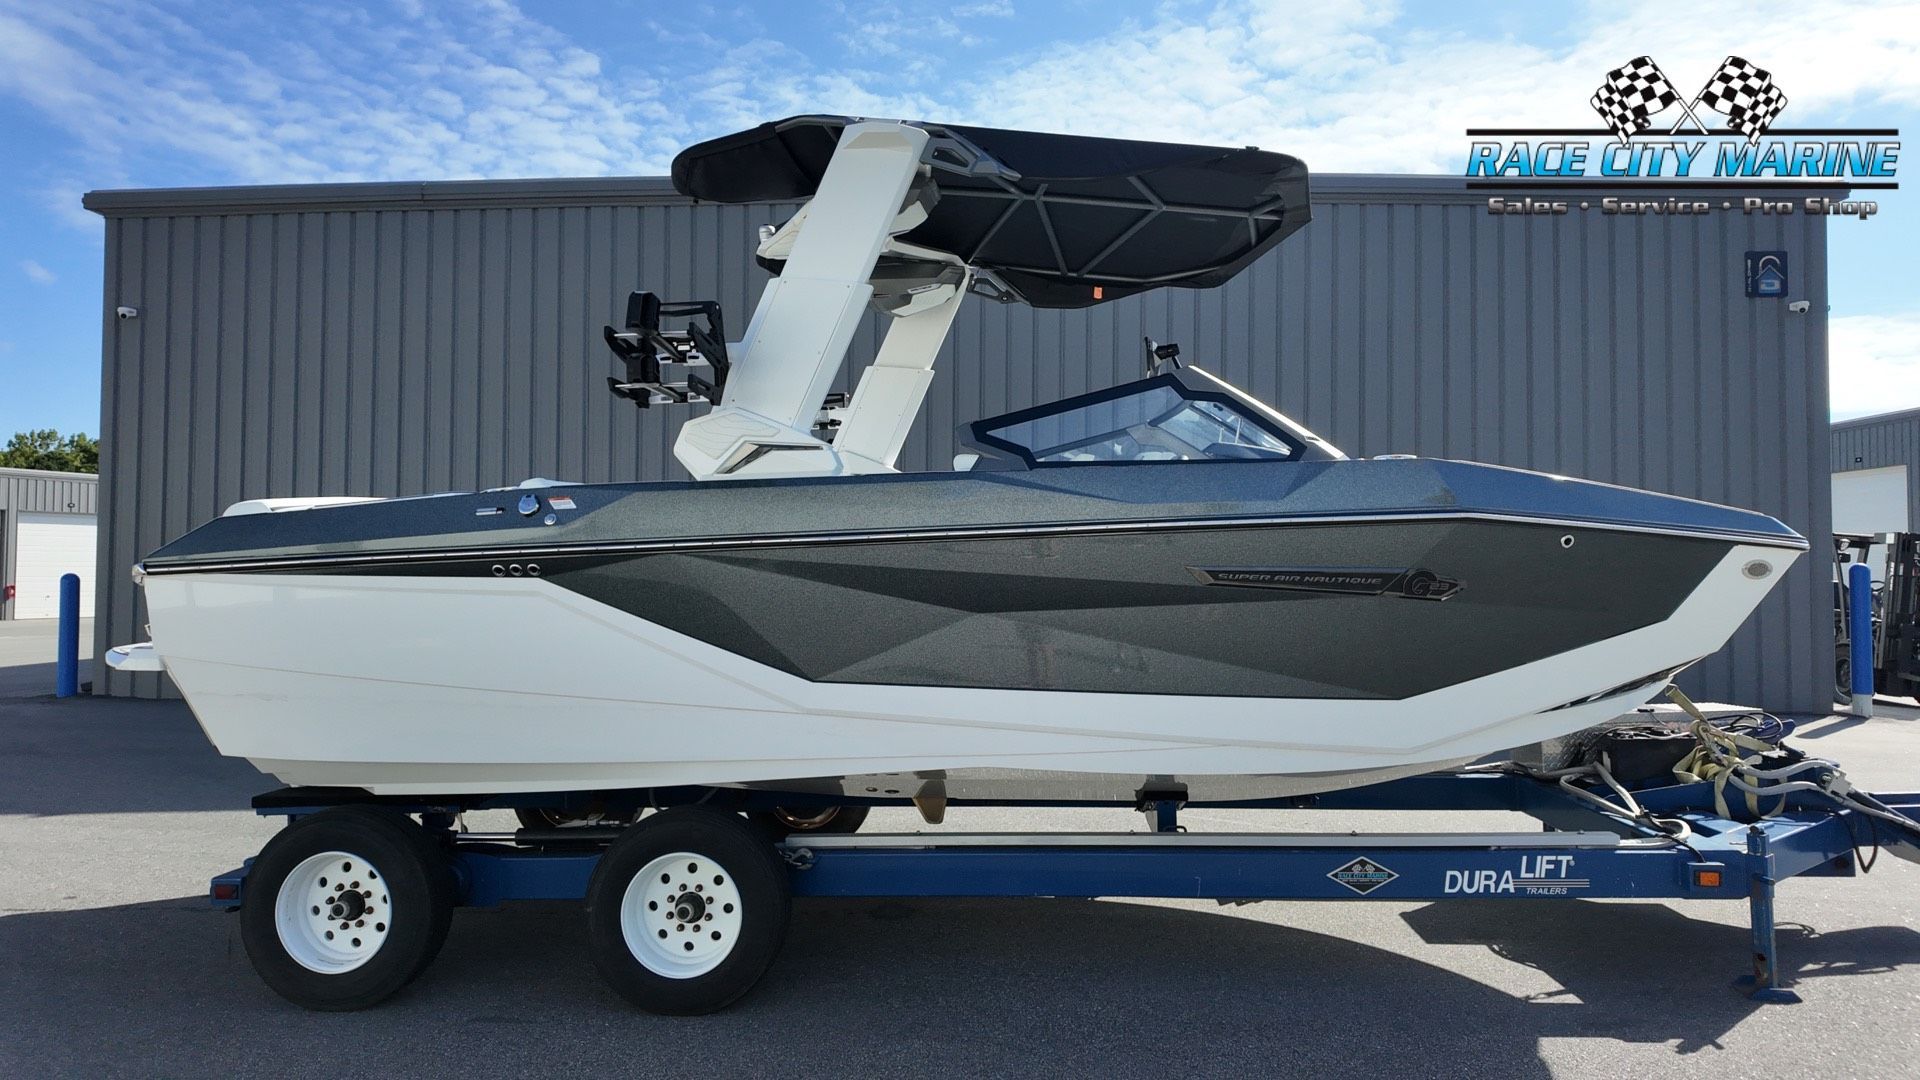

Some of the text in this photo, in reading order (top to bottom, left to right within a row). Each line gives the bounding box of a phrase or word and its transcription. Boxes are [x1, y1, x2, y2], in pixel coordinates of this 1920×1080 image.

[1218, 573, 1271, 581] SUPER
[1304, 576, 1383, 585] NAUTIQUE
[1444, 855, 1573, 894] DURA LIFT
[1526, 887, 1568, 895] TRAILERS
